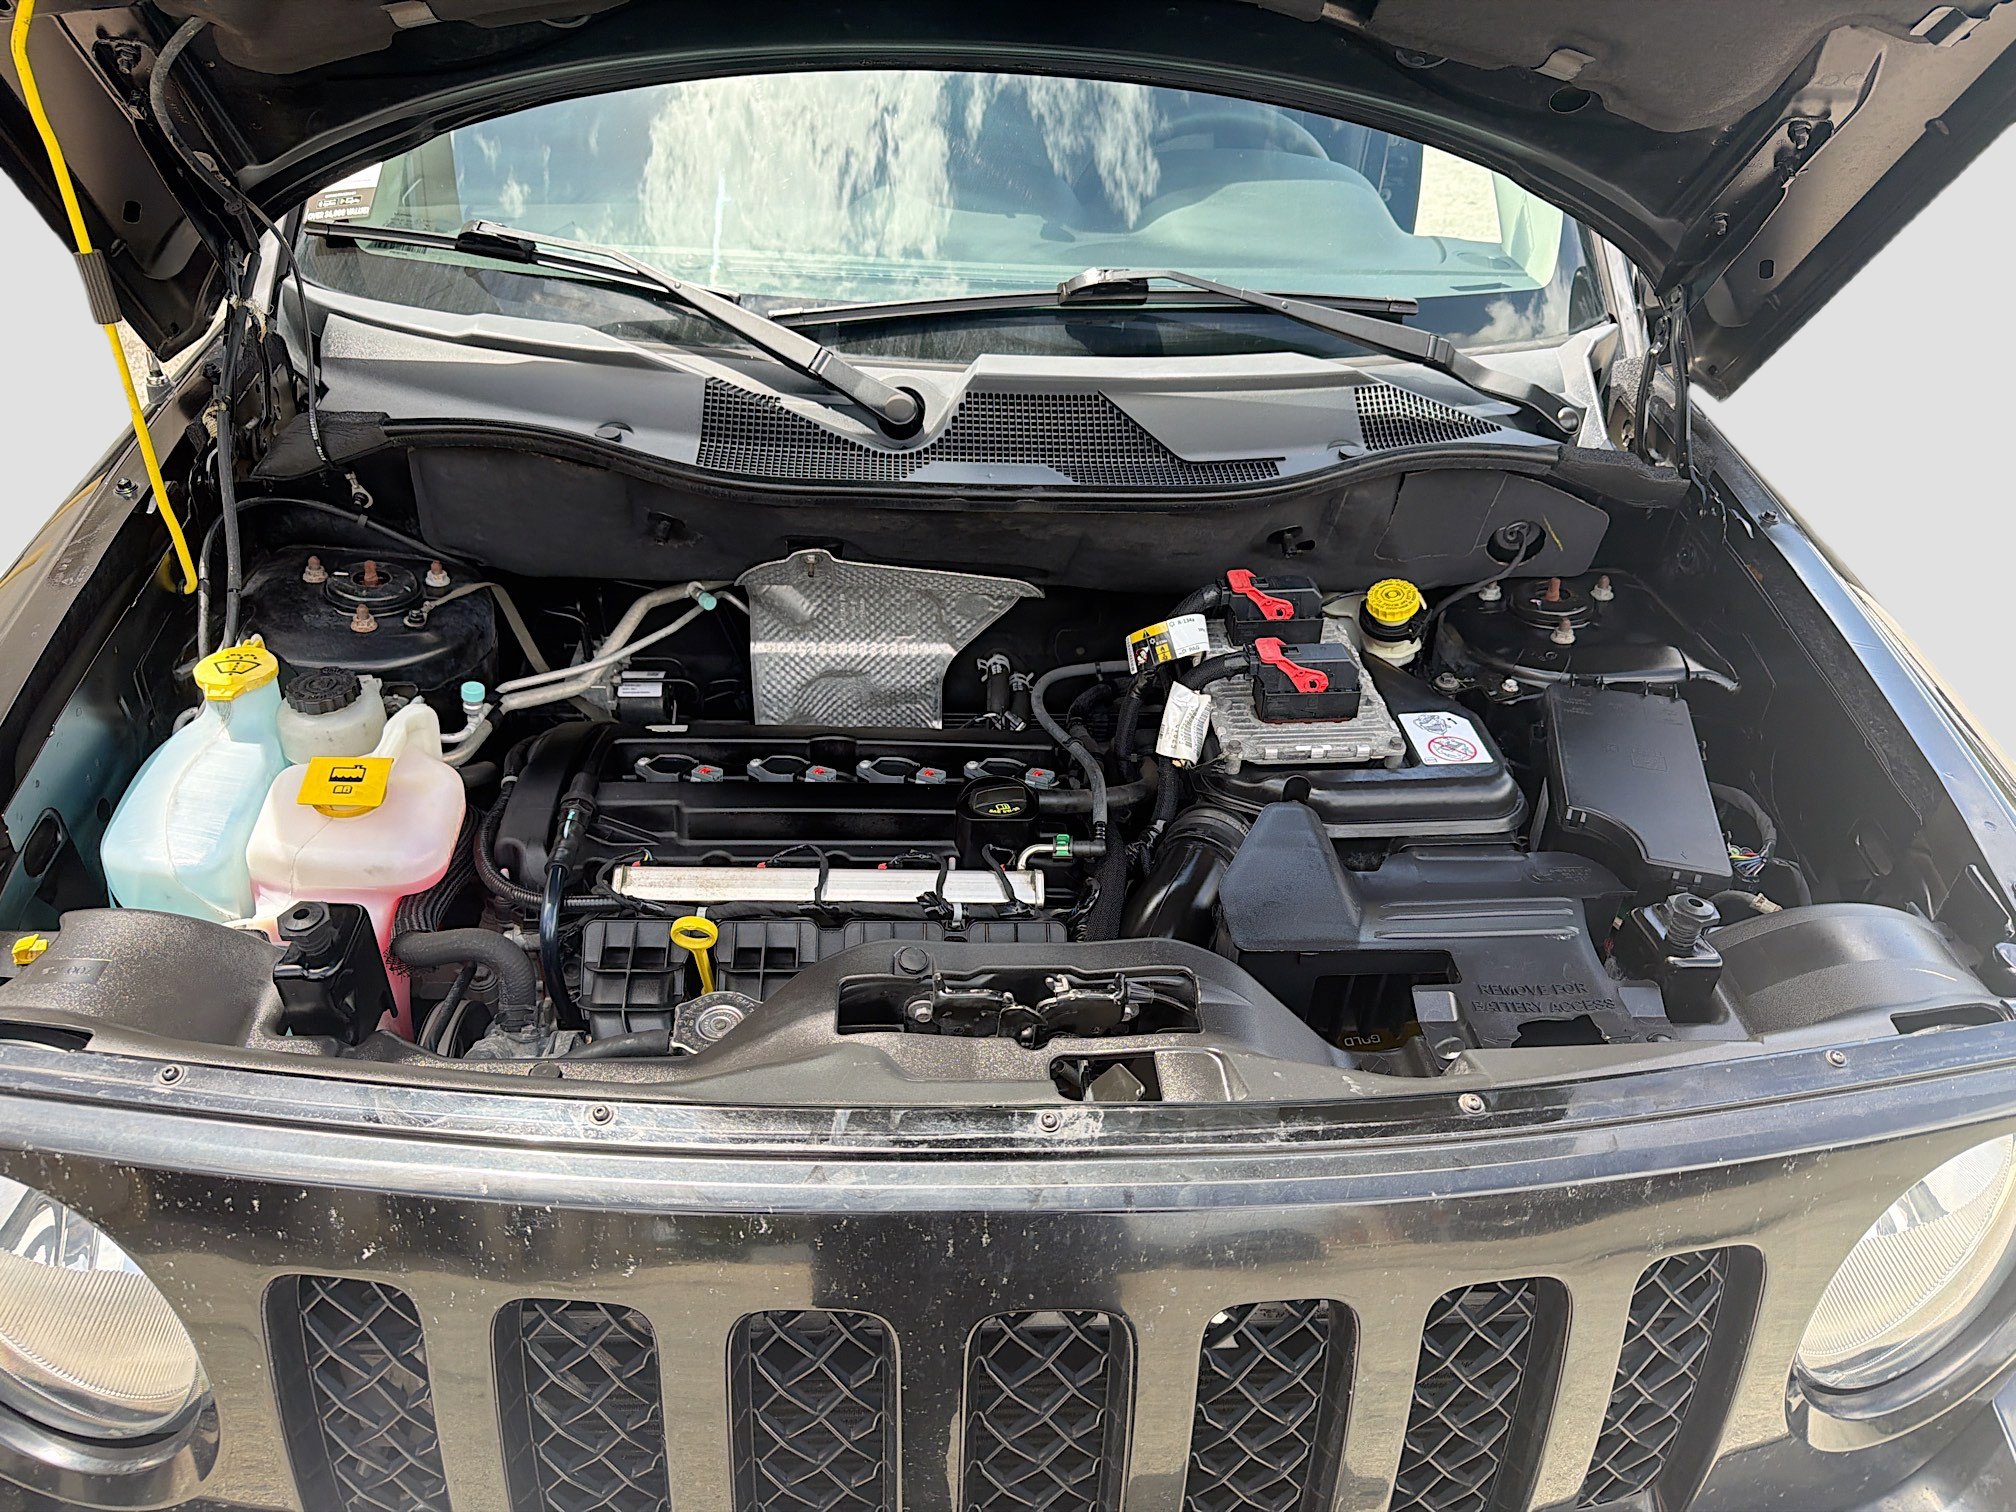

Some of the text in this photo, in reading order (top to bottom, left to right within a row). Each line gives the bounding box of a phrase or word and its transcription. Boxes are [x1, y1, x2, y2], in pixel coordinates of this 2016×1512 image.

[1478, 982, 1587, 996] REMOVE FOR
[1472, 998, 1616, 1013] BATTERY ACCESS
